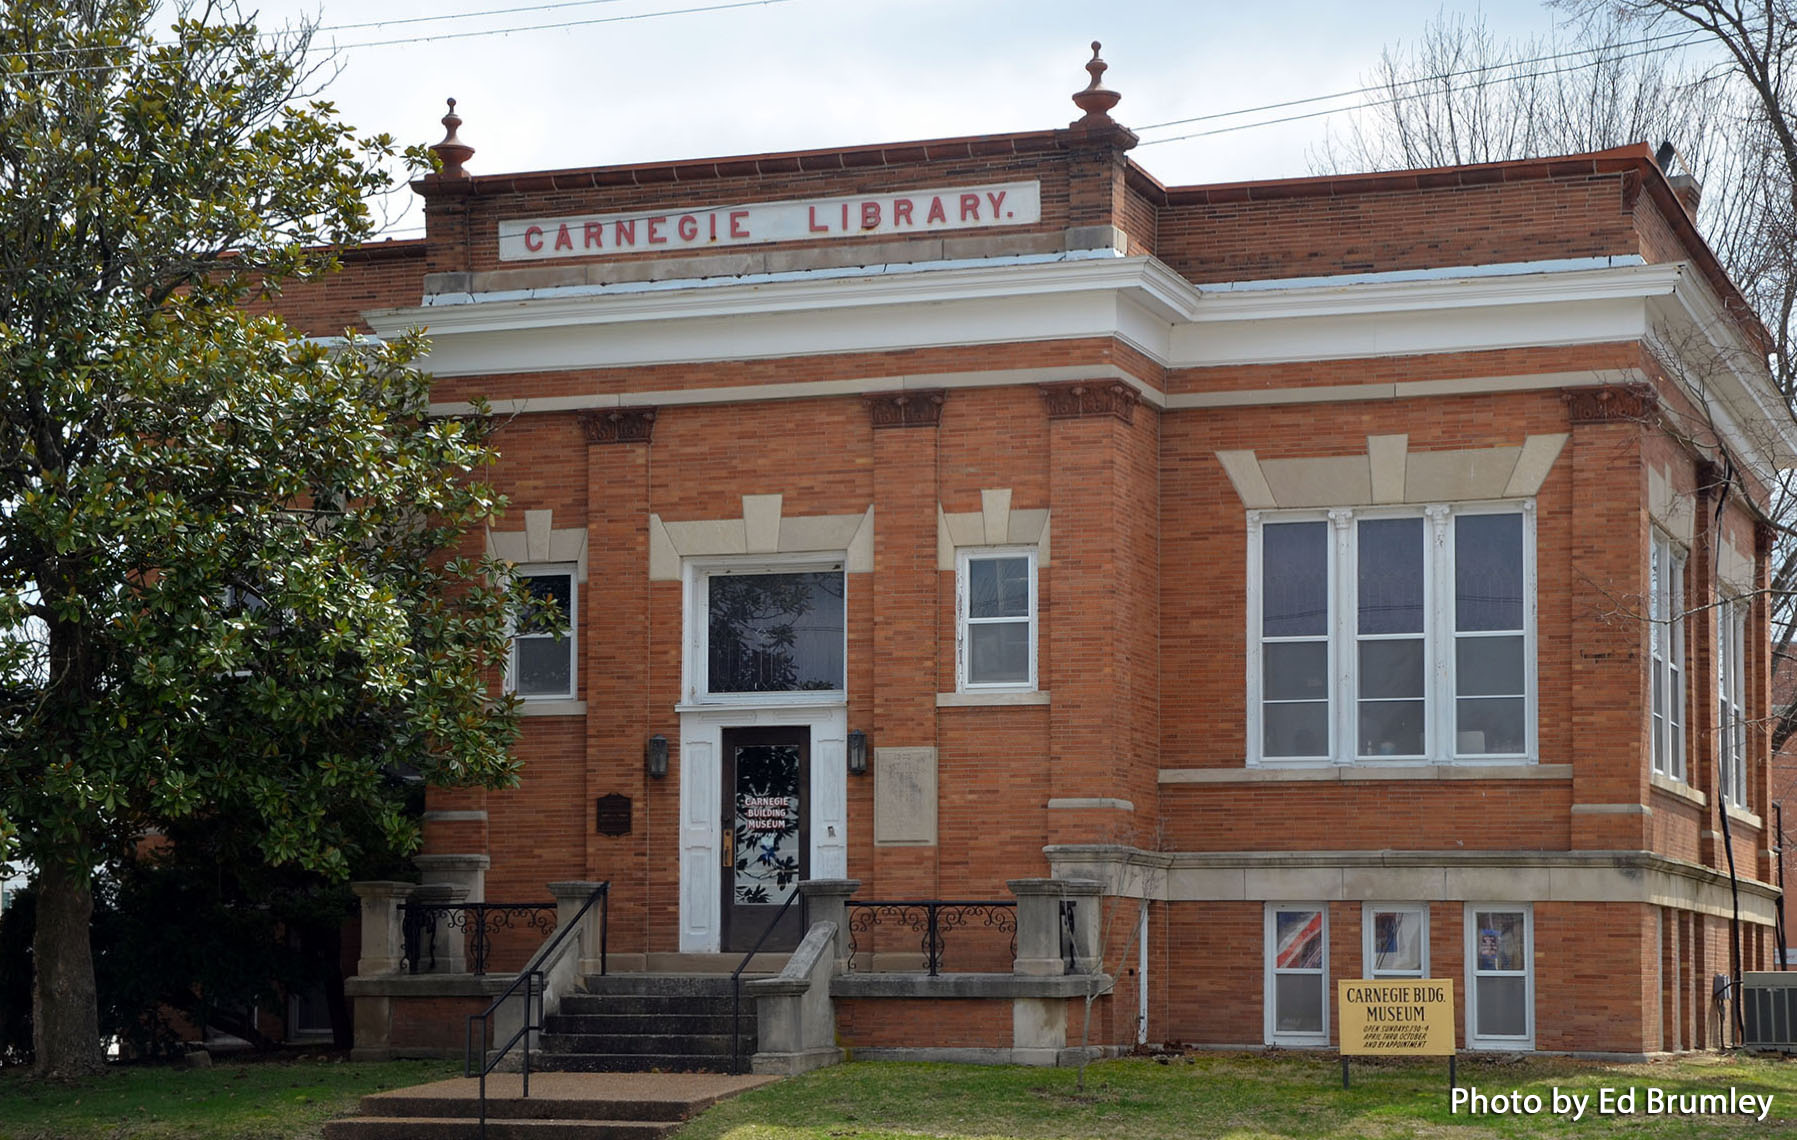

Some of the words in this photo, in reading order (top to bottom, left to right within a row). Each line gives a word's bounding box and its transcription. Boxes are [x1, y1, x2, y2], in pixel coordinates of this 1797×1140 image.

[524, 210, 751, 253] CARNEGIE
[808, 190, 1015, 233] LIBRARY.
[744, 797, 789, 806] CARNEGIE
[747, 808, 786, 818] BUILDING
[747, 819, 786, 829] MUSEUM
[1347, 987, 1411, 1003] CARNEGIE
[1413, 987, 1446, 1003] BLDG.
[1367, 1006, 1425, 1022] MUSEUM
